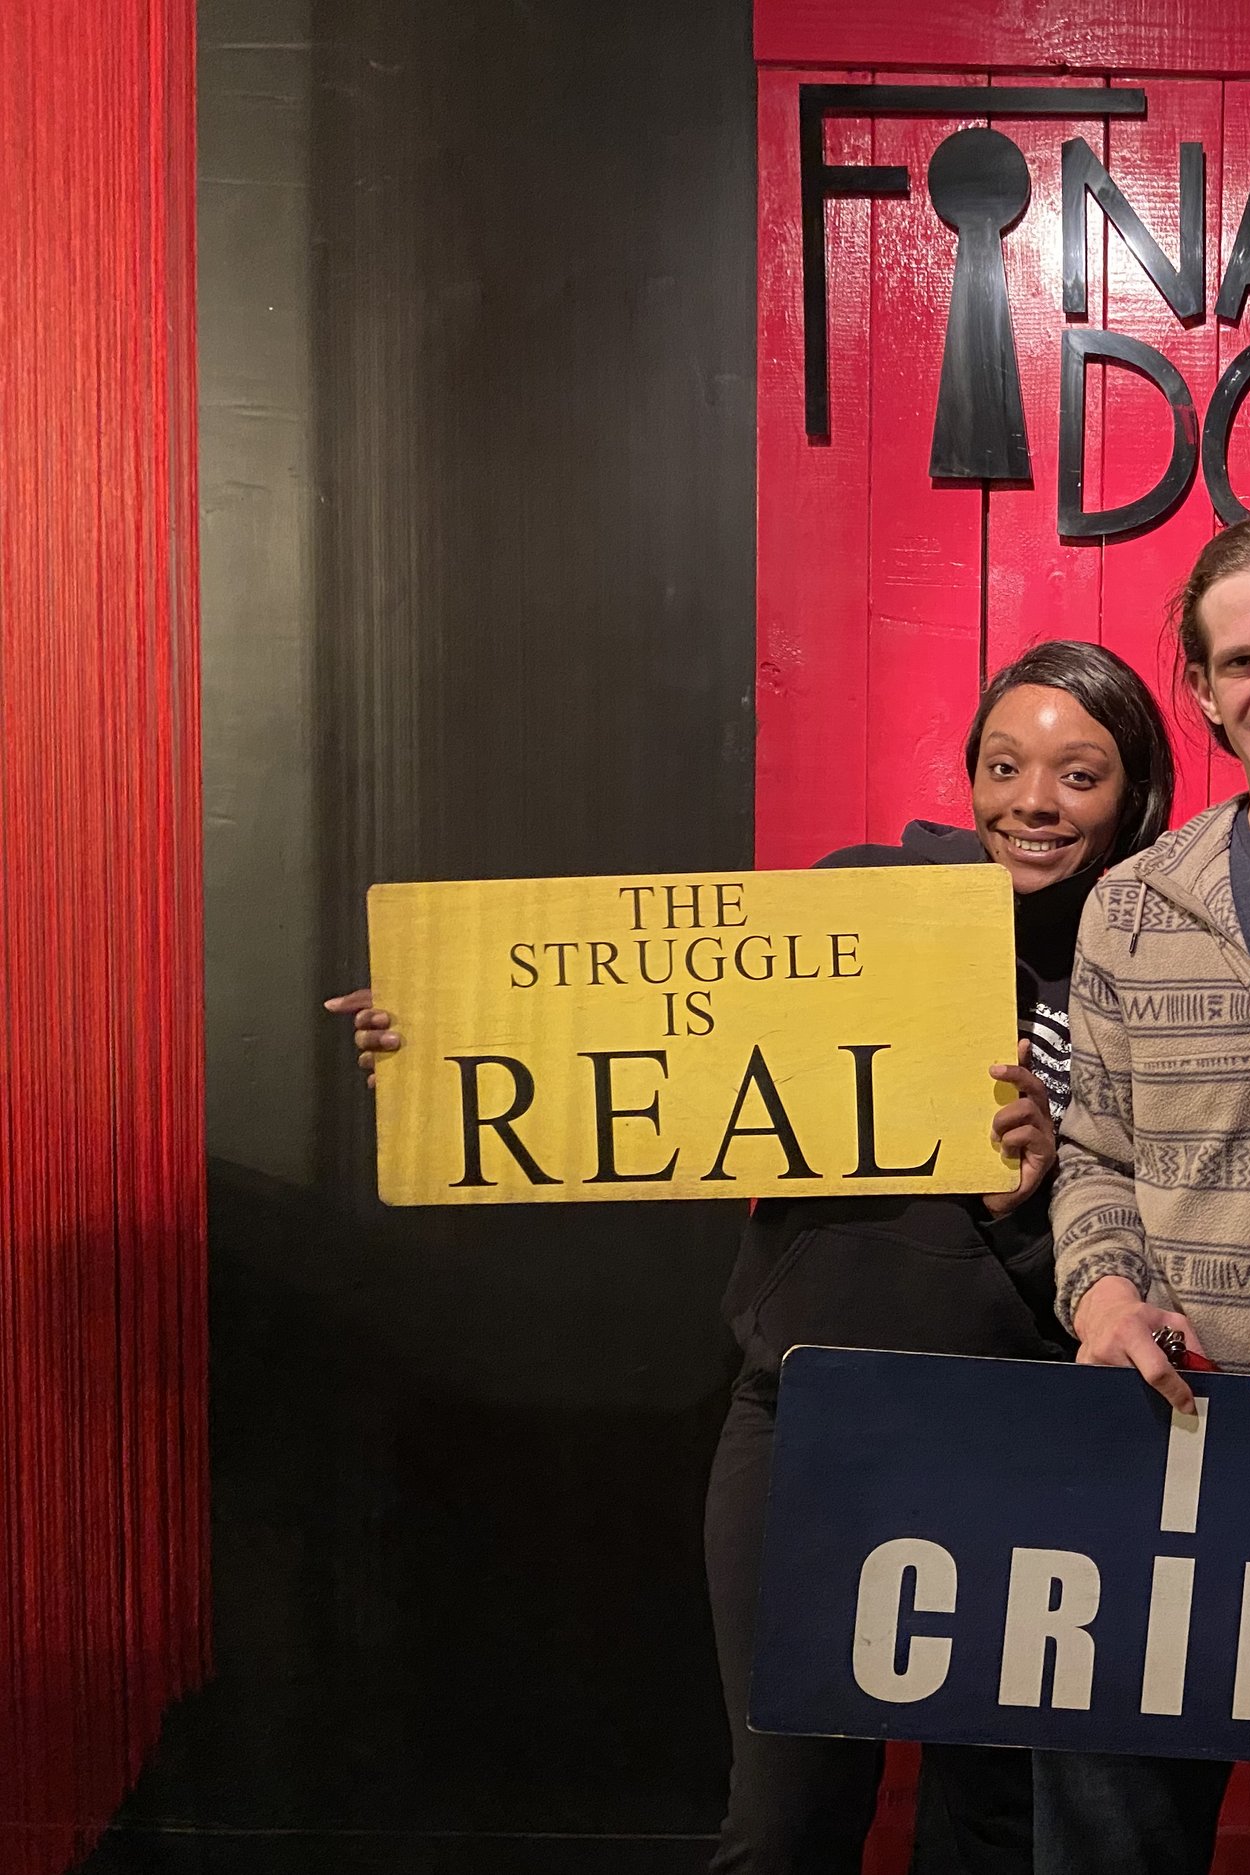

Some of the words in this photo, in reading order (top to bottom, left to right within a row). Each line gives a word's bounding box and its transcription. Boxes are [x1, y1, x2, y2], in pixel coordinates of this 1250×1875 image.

[619, 883, 749, 930] THE
[509, 933, 864, 988] STRUGGLE
[662, 991, 715, 1037] IS
[444, 1044, 942, 1188] REAL
